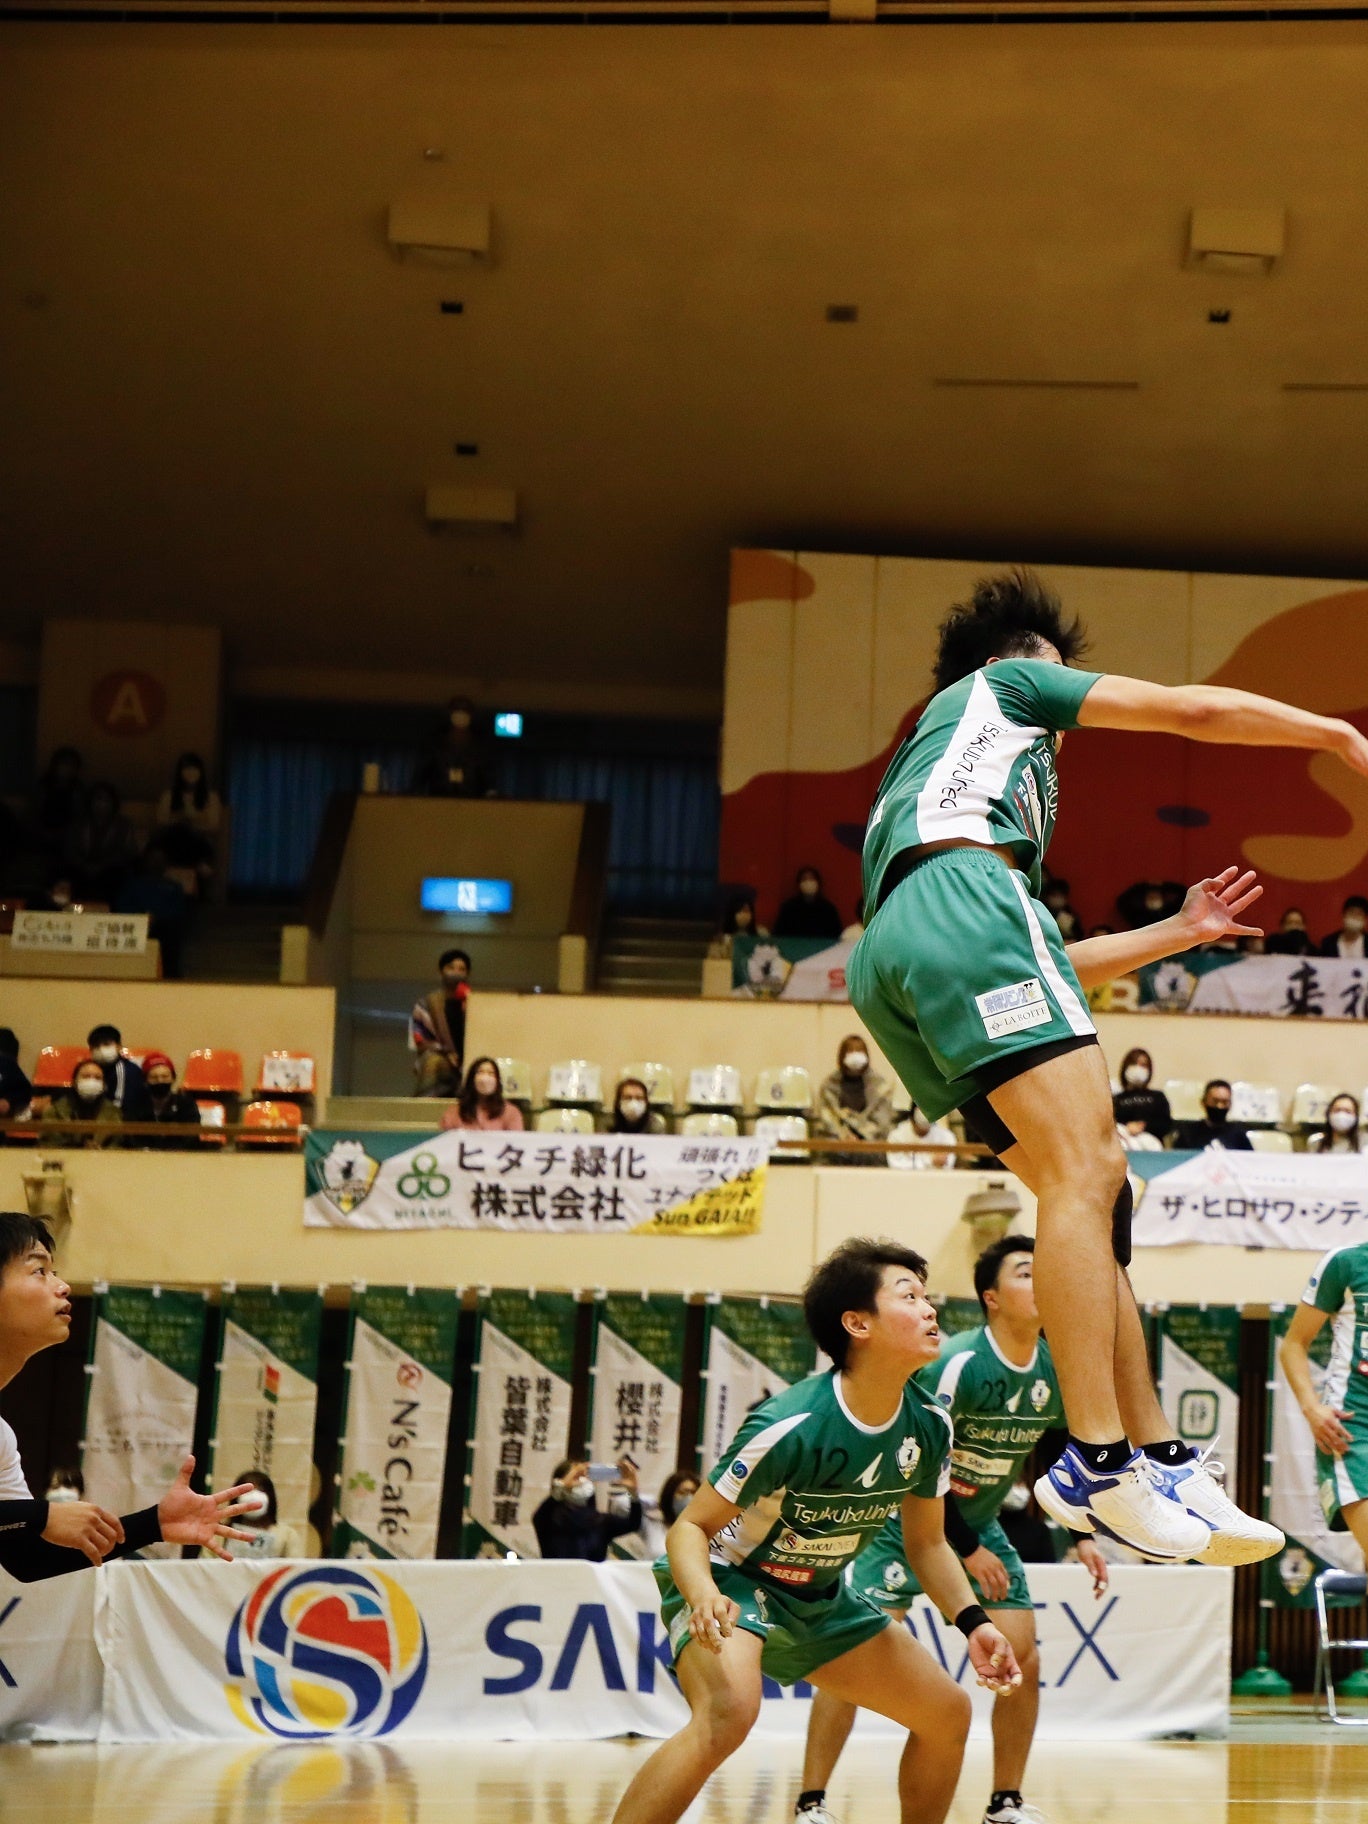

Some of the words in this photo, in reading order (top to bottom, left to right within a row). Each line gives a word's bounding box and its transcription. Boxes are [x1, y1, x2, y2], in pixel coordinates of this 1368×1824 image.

[106, 681, 149, 727] A
[456, 1142, 647, 1181] ヒタチ緑化
[470, 1181, 626, 1221] 株式会社
[975, 1379, 1008, 1413] 23
[811, 1446, 849, 1491] 12
[376, 1456, 413, 1537] Café
[793, 1502, 866, 1524] Tsukuba
